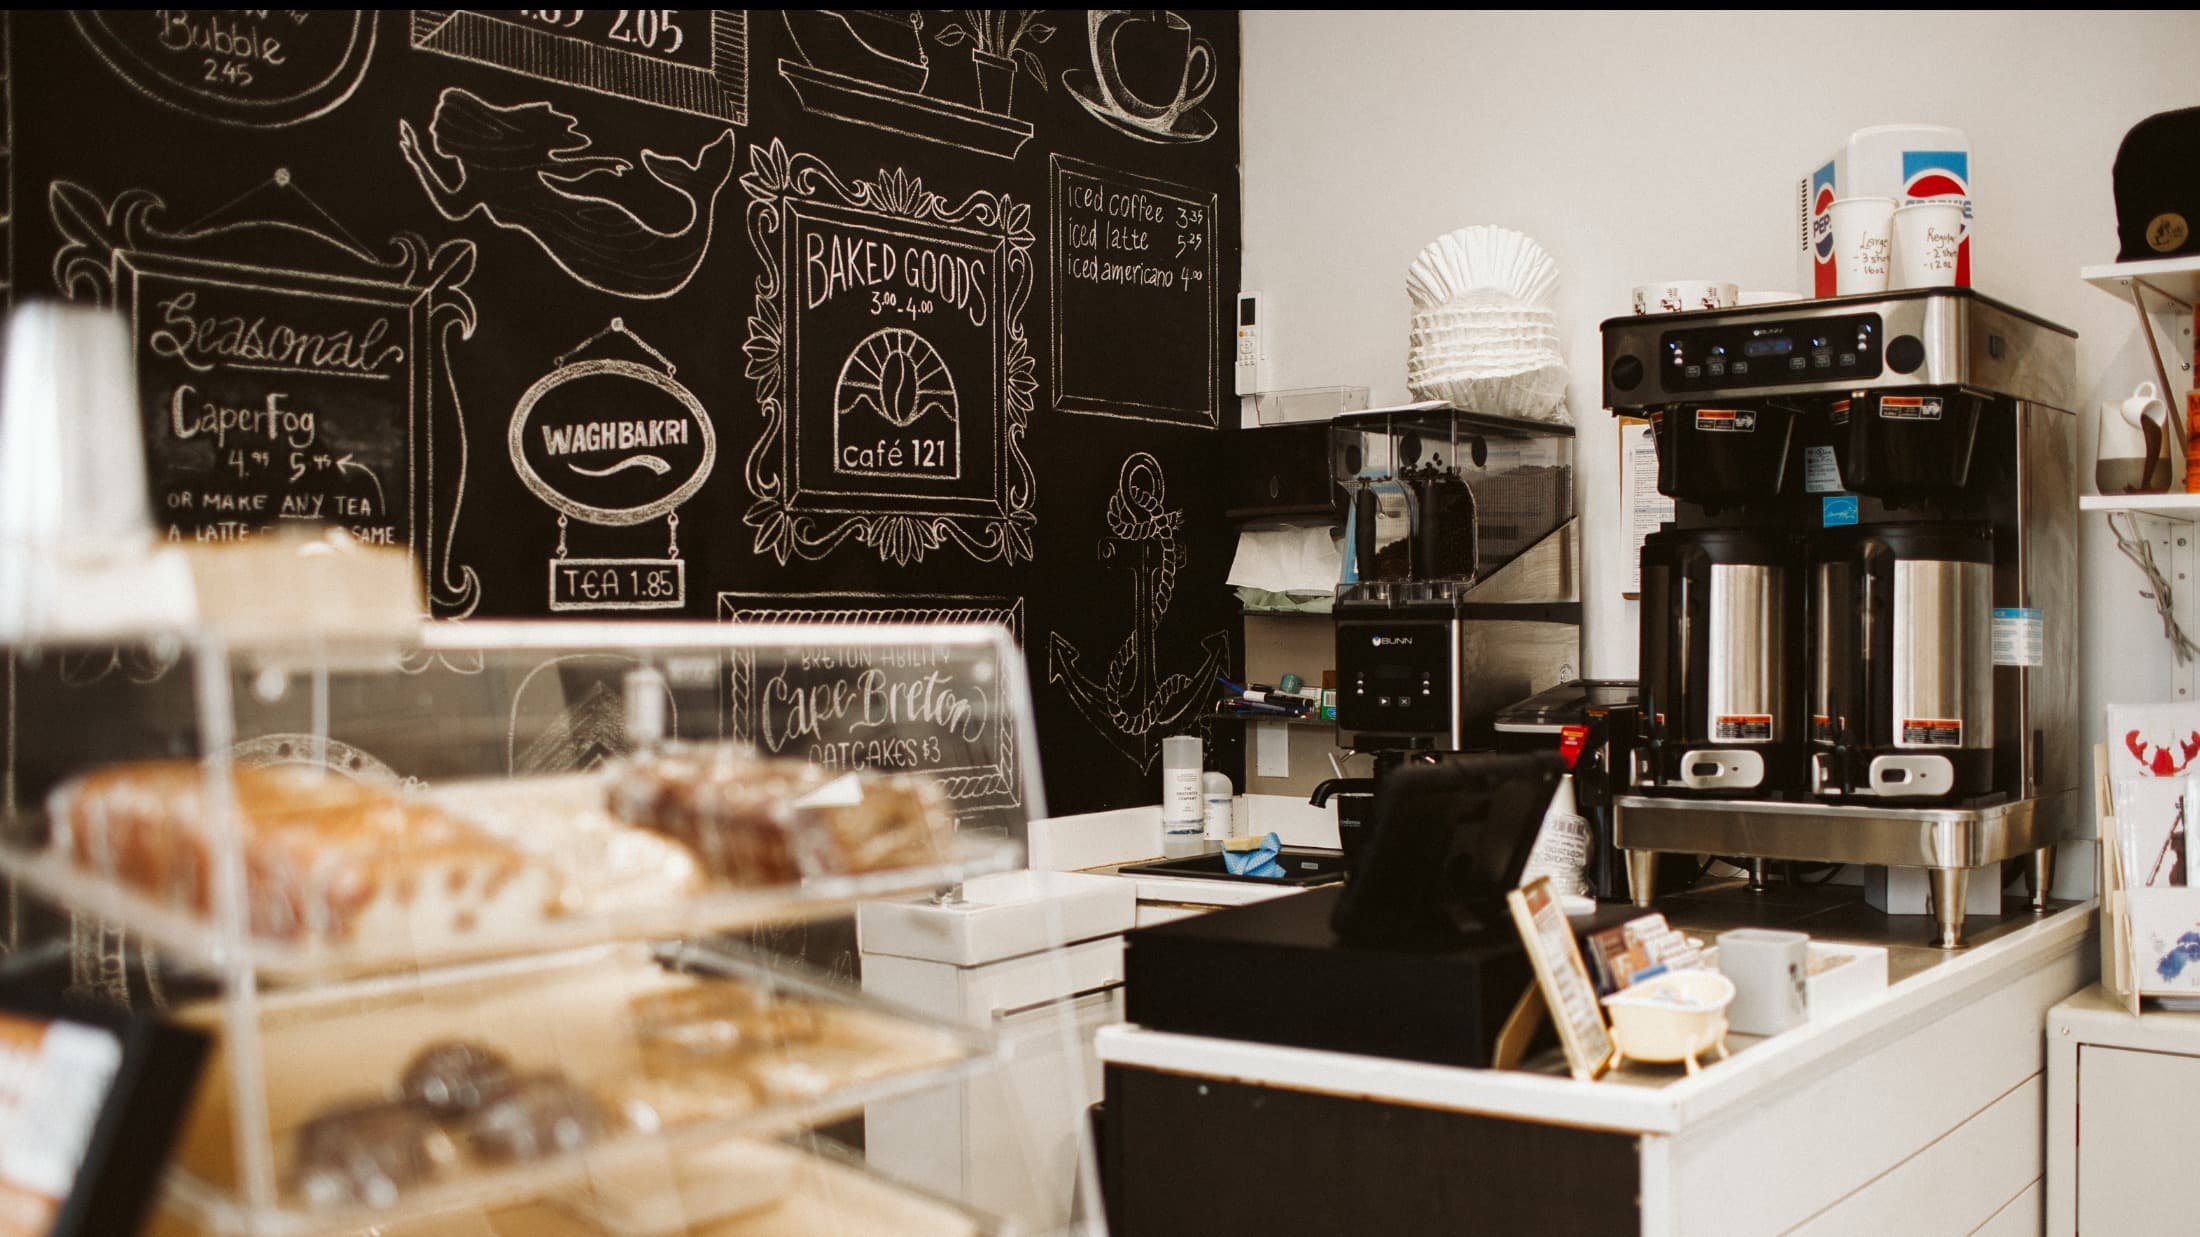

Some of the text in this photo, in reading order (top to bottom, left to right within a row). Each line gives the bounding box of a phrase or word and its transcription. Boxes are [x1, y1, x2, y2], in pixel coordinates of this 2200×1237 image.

[156, 10, 286, 65] Bubble
[608, 10, 683, 53] 2.05
[1068, 176, 1104, 212] iced
[1109, 194, 1164, 222] coffee
[1068, 217, 1097, 250] iced
[1106, 220, 1150, 250] latte
[1813, 213, 1832, 239] PEP
[807, 233, 987, 327] BAKED GOODS
[1068, 253, 1203, 292] iced americano 4.00
[151, 292, 404, 372] Seasonal
[541, 418, 689, 456] WAGHBAKRI
[843, 438, 945, 468] café 121
[167, 491, 373, 517] OR MAKE ANY TEA
[168, 524, 182, 542] A
[195, 520, 250, 542] LATTE
[352, 526, 397, 545] SAME
[562, 569, 674, 599] TEA 1.85
[1381, 637, 1413, 645] BUNN
[801, 647, 951, 671] BRETON ABILITY
[762, 658, 988, 752] Cape Breton
[809, 736, 941, 771] OATCAKES $3
